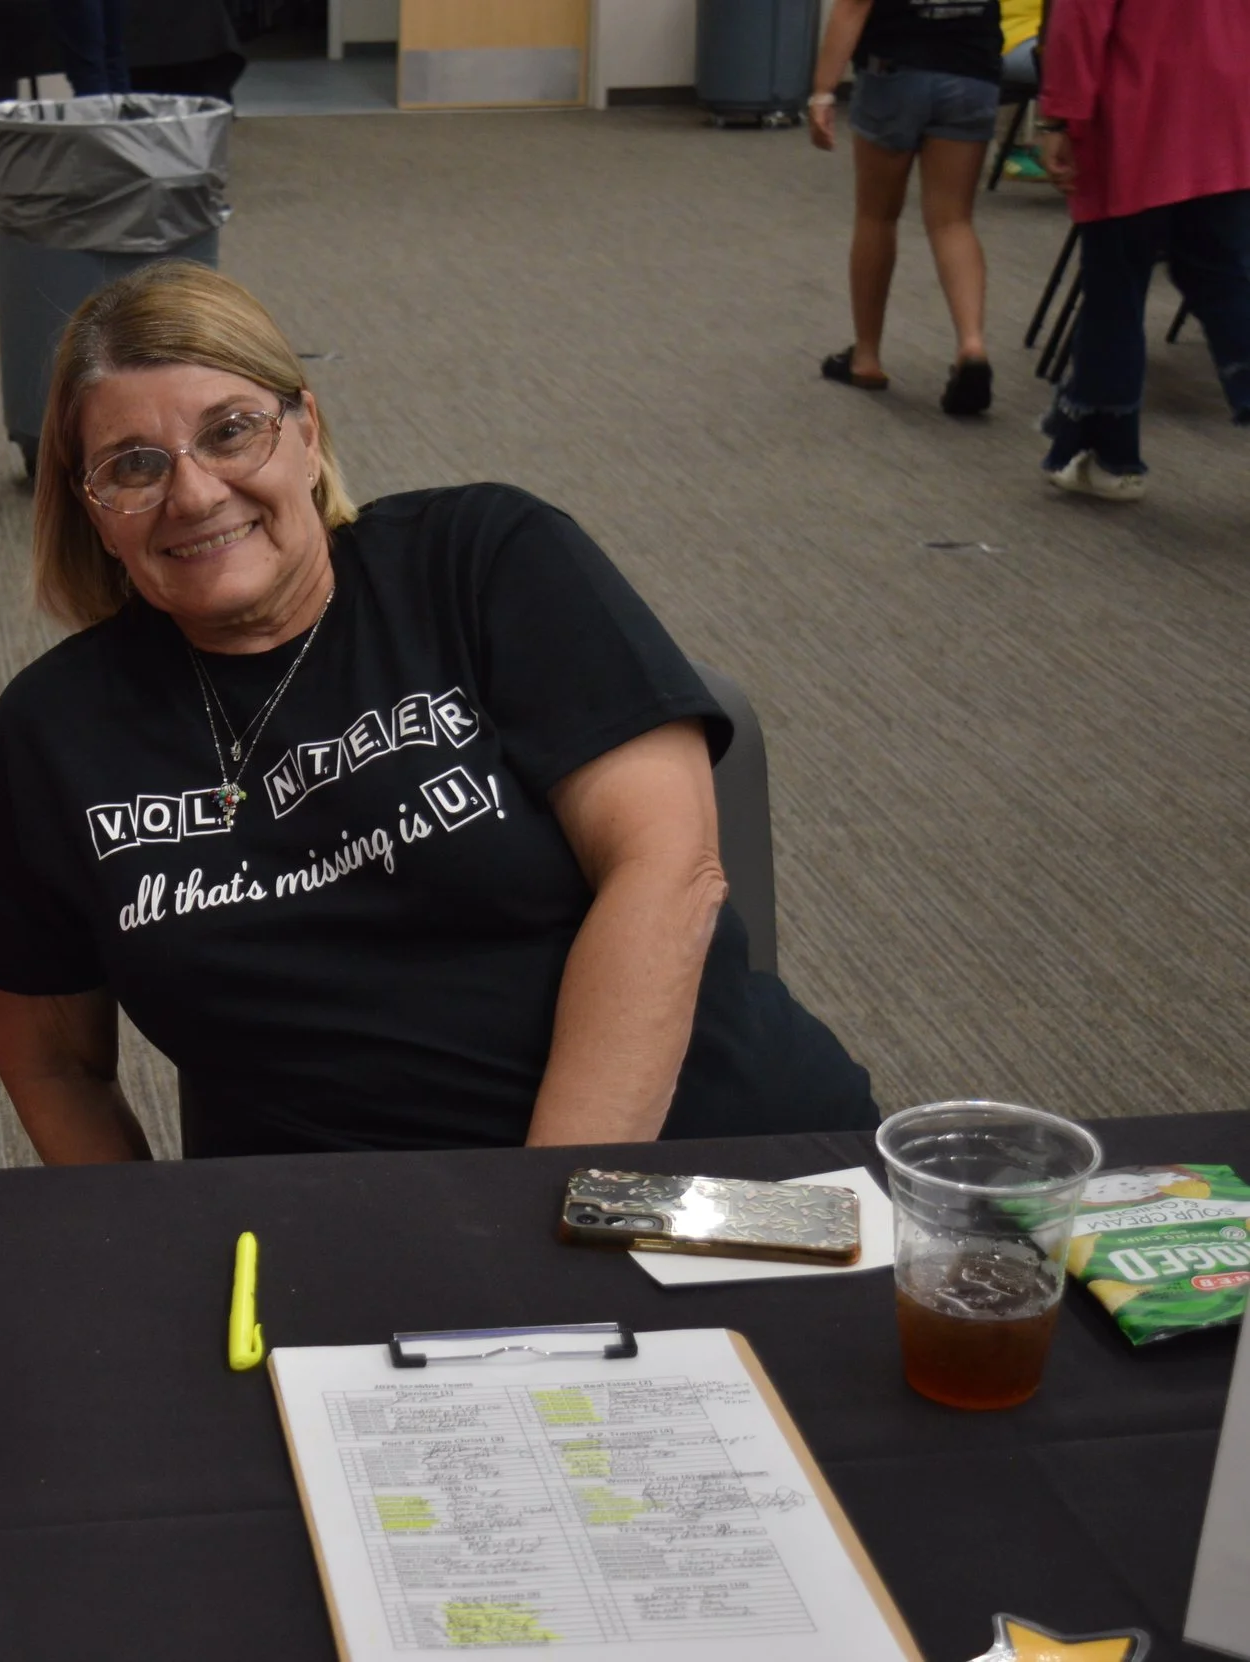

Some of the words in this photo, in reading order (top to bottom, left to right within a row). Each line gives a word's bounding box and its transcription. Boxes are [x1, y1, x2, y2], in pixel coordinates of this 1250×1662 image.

[119, 873, 167, 931] all
[175, 860, 267, 913] that's
[275, 829, 395, 898] missing
[399, 803, 432, 844] is
[1104, 1200, 1179, 1219] ONION
[1174, 1207, 1236, 1221] SOUR
[1088, 1211, 1167, 1230] CREAM
